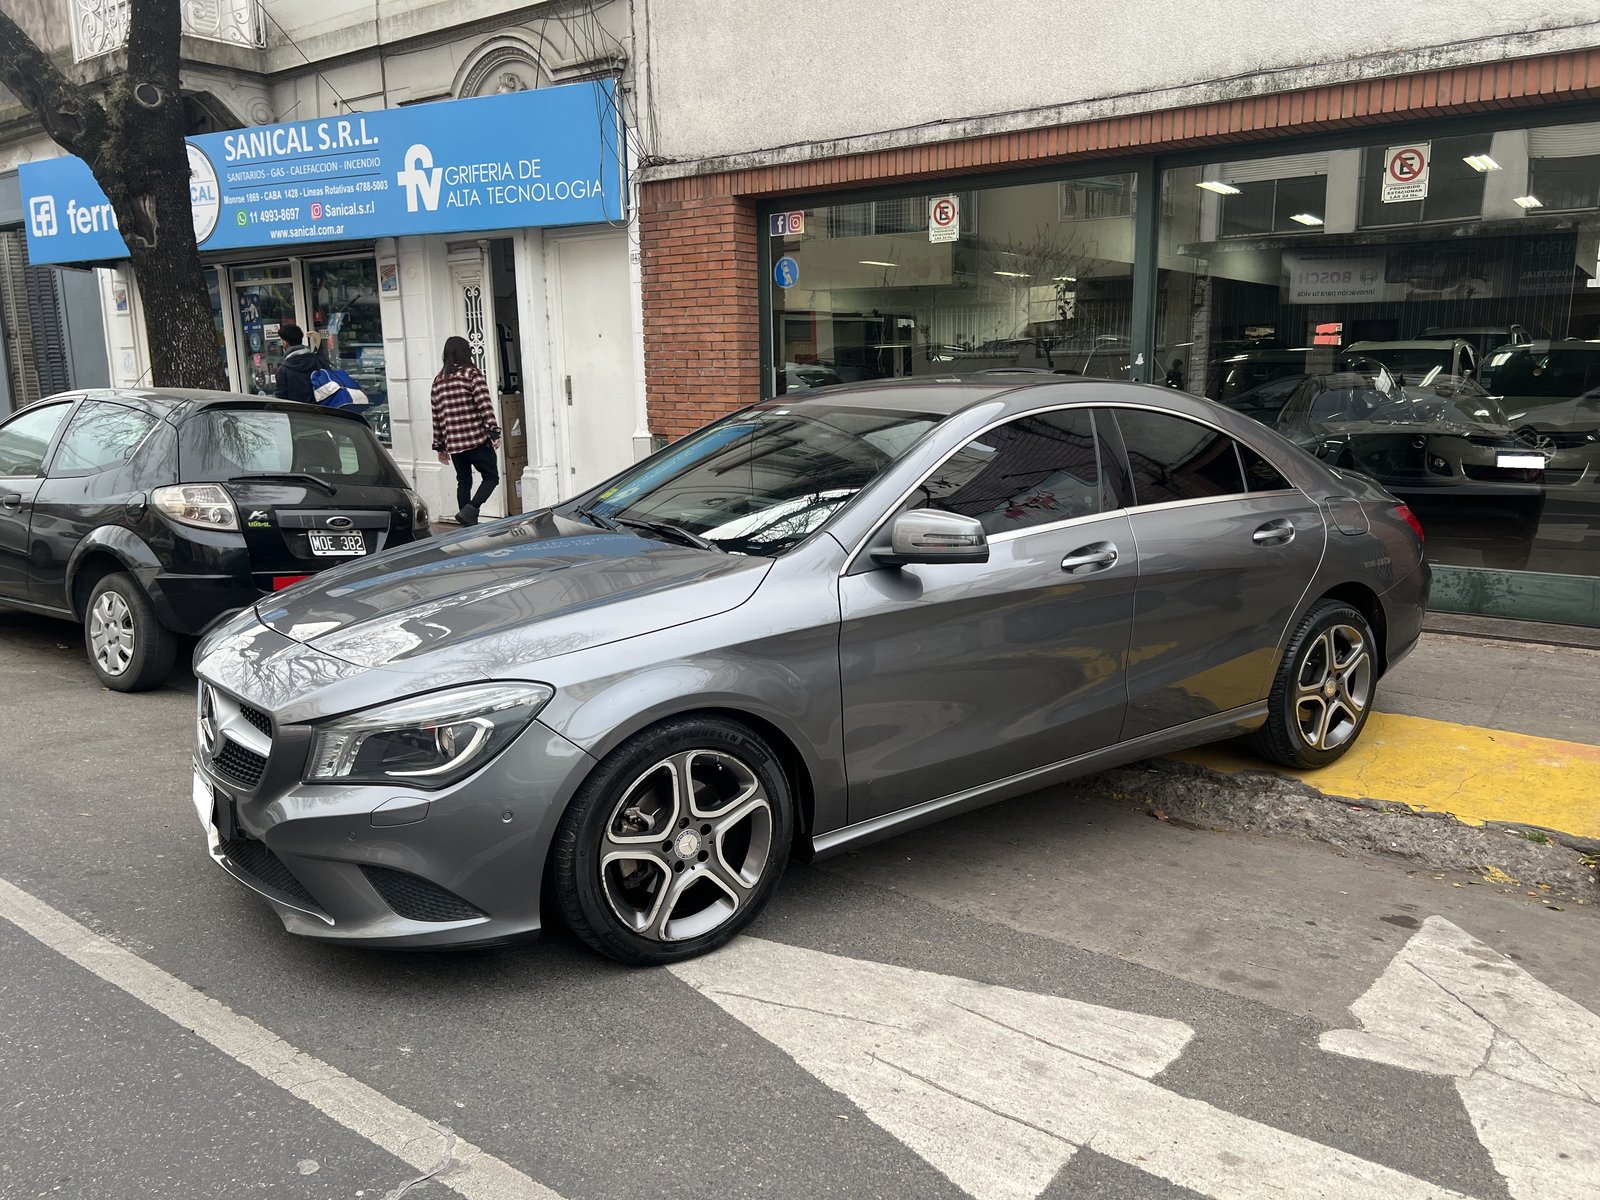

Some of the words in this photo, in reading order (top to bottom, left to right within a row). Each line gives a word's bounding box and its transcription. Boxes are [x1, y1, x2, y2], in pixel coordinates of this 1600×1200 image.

[223, 126, 313, 161] SANICAL
[317, 118, 379, 151] S.R.L.
[227, 169, 265, 183] SANITARIOS
[270, 166, 285, 178] GAS
[290, 160, 338, 176] CALEFACCION
[343, 157, 381, 170] INCENDIO
[445, 162, 514, 186] GRIFERIA
[519, 158, 542, 179] DE
[190, 185, 216, 203] CAL
[223, 195, 245, 205] Monroe
[264, 190, 282, 201] CABA
[284, 189, 299, 199] 1428
[325, 183, 354, 195] Rotativas
[355, 180, 388, 193] 4788-5003
[446, 188, 481, 208] ALTA
[487, 179, 605, 205] TECNOLOGIA
[249, 211, 258, 224] 11
[260, 208, 300, 222] 4993-8697
[325, 201, 375, 218] Sanical.s.r.l
[270, 224, 344, 239] www.sanical.com.ar
[312, 536, 337, 551] MOE
[340, 536, 364, 550] 382
